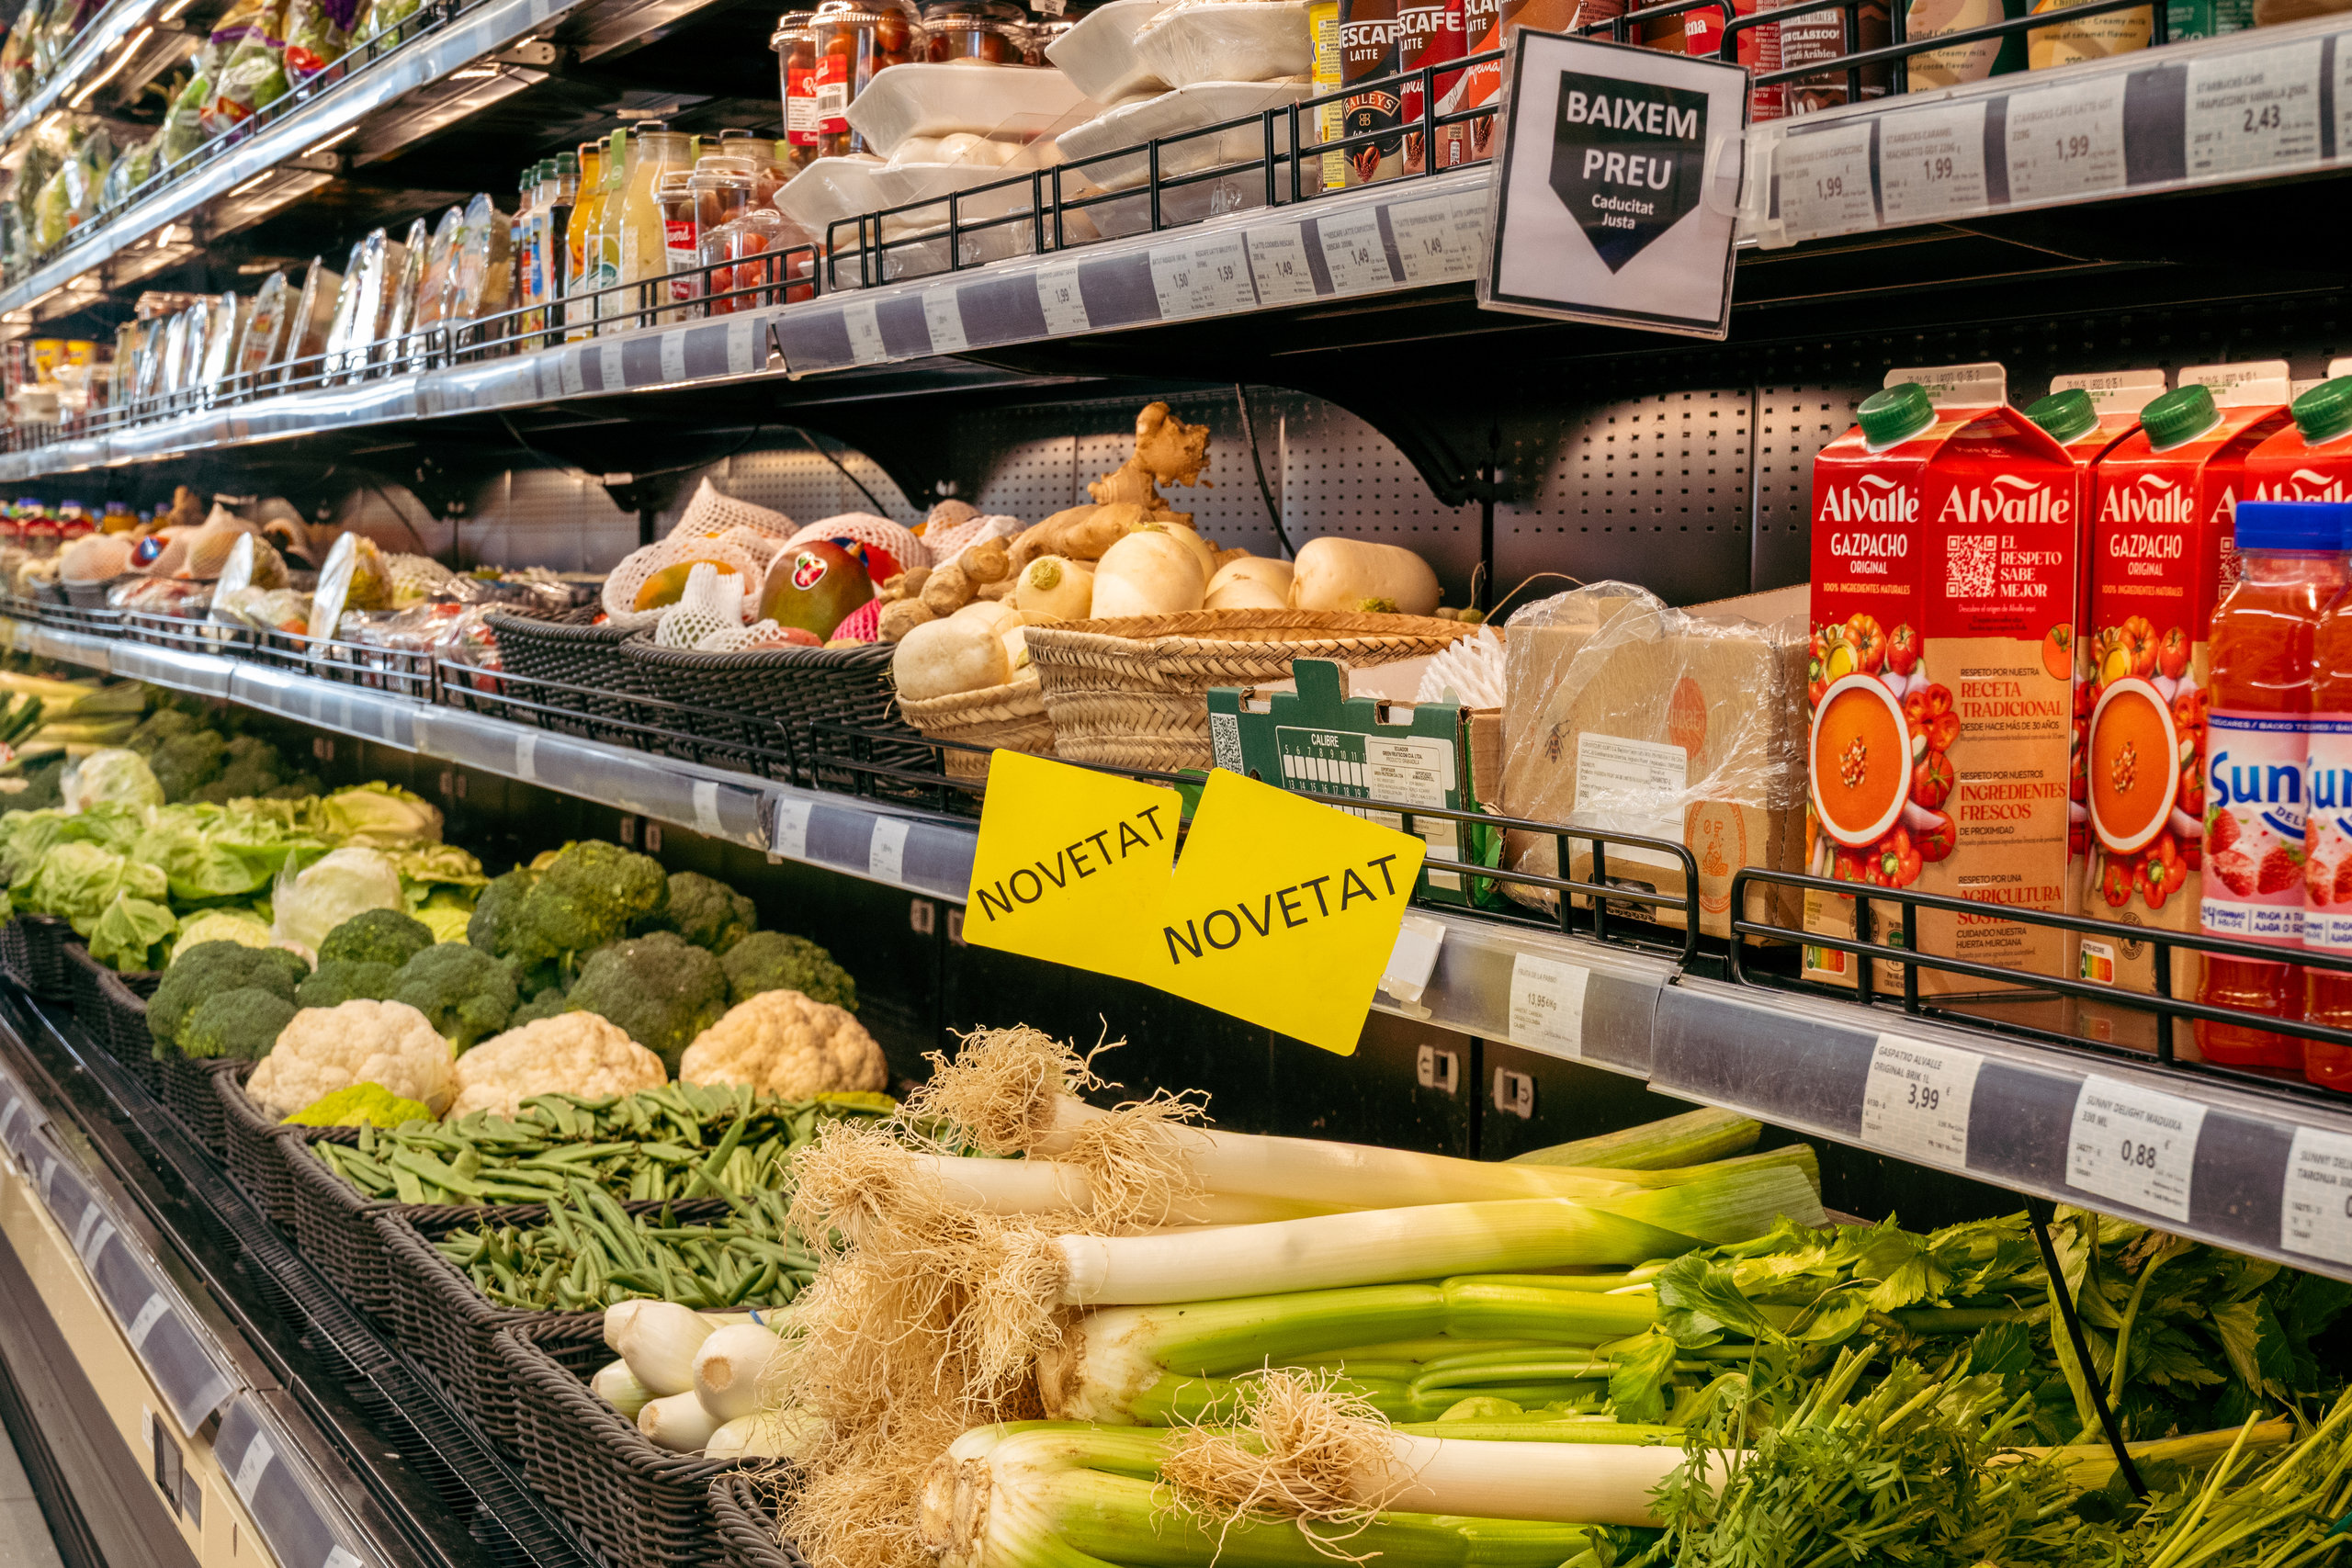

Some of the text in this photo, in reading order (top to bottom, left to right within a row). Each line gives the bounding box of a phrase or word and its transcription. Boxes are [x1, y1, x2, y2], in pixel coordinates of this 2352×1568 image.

[2093, 18, 2125, 27] Creamy
[1792, 28, 1840, 41] CLÁSICO!
[2108, 29, 2138, 38] flavour
[1350, 49, 1378, 62] LATTE
[1804, 49, 1838, 60] Arábica
[1938, 48, 1986, 59] Creamy milk
[1344, 93, 1395, 110] BAILEYS
[1566, 90, 1697, 140] BAIXEM
[2243, 104, 2281, 134] 2,43
[2055, 134, 2090, 163] 1,99
[1582, 148, 1672, 191] PREU
[1924, 157, 1952, 184] 1,99
[1816, 175, 1843, 201] 1,99
[1591, 193, 1655, 216] Caducitat
[1601, 212, 1636, 231] Justa
[1423, 237, 1442, 256] 1,49
[1351, 247, 1369, 266] 1,49
[1217, 265, 1234, 283] 1,59
[1275, 261, 1293, 278] 1,49
[1173, 273, 1189, 289] 1,50
[1055, 288, 1069, 304] 1,99
[1819, 474, 1920, 524] Alvalle
[1938, 474, 2071, 525] Alvalle
[2099, 473, 2194, 524] Alvalle
[1830, 533, 1908, 558] GAZPACHO
[2001, 535, 2018, 549] EL
[2109, 534, 2183, 558] GAZPACHO
[1849, 560, 1888, 574] ORIGINAL
[2001, 551, 2063, 566] RESPETO
[2000, 568, 2036, 581] SABE
[2128, 561, 2164, 576] ORIGINAL
[1823, 582, 1911, 595] 100% INGREDIENTES NATURALES
[2000, 583, 2048, 598] MEJOR
[1961, 667, 2040, 677] RESPETO POR NUESTRA
[1961, 682, 2021, 698] RECETA
[1961, 701, 2064, 718] TRADICIONAL
[1961, 719, 2060, 731] DESDE HACE MÁS DE 30 AÑOS
[1311, 733, 1340, 748] CALIBRE
[1284, 744, 1289, 754] 5
[1295, 746, 1301, 755] 6
[1306, 747, 1311, 756] 7
[1318, 748, 1323, 758] 8
[1329, 749, 1334, 759] 9
[1340, 750, 1347, 761] 10
[1351, 751, 1358, 761] 11
[1960, 770, 2044, 780] RESPETO POR NUESTROS
[2211, 750, 2301, 808] Sun
[1288, 780, 1361, 798] 13 14 15 16 17 18 19
[1961, 783, 2066, 802] INGREDIENTES
[1960, 803, 2031, 821] FRESCOS
[1959, 826, 2014, 836] DE PROXIMIDAD
[976, 805, 1167, 922] NOVETAT
[1958, 874, 2022, 885] RESPETO POR UNA
[1961, 886, 2061, 905] AGRICULTURA
[1163, 853, 1399, 964] NOVETAT
[1956, 927, 2027, 939] CUIDANDO NUESTRA
[1956, 938, 2022, 949] HUERTA MURCIANA
[1528, 992, 1545, 1008] 13,95
[1878, 1046, 1943, 1070] GASPATXO ALVALLE
[1874, 1061, 1929, 1084] ORIGINAL BRIK 1L
[1907, 1083, 1939, 1111] 3,99
[2082, 1111, 2108, 1128] 330 ML
[2086, 1094, 2183, 1132] SUNNY DELIGHT MADUIXA
[2120, 1139, 2156, 1169] 0,88
[2300, 1150, 2332, 1166] SUNNY
